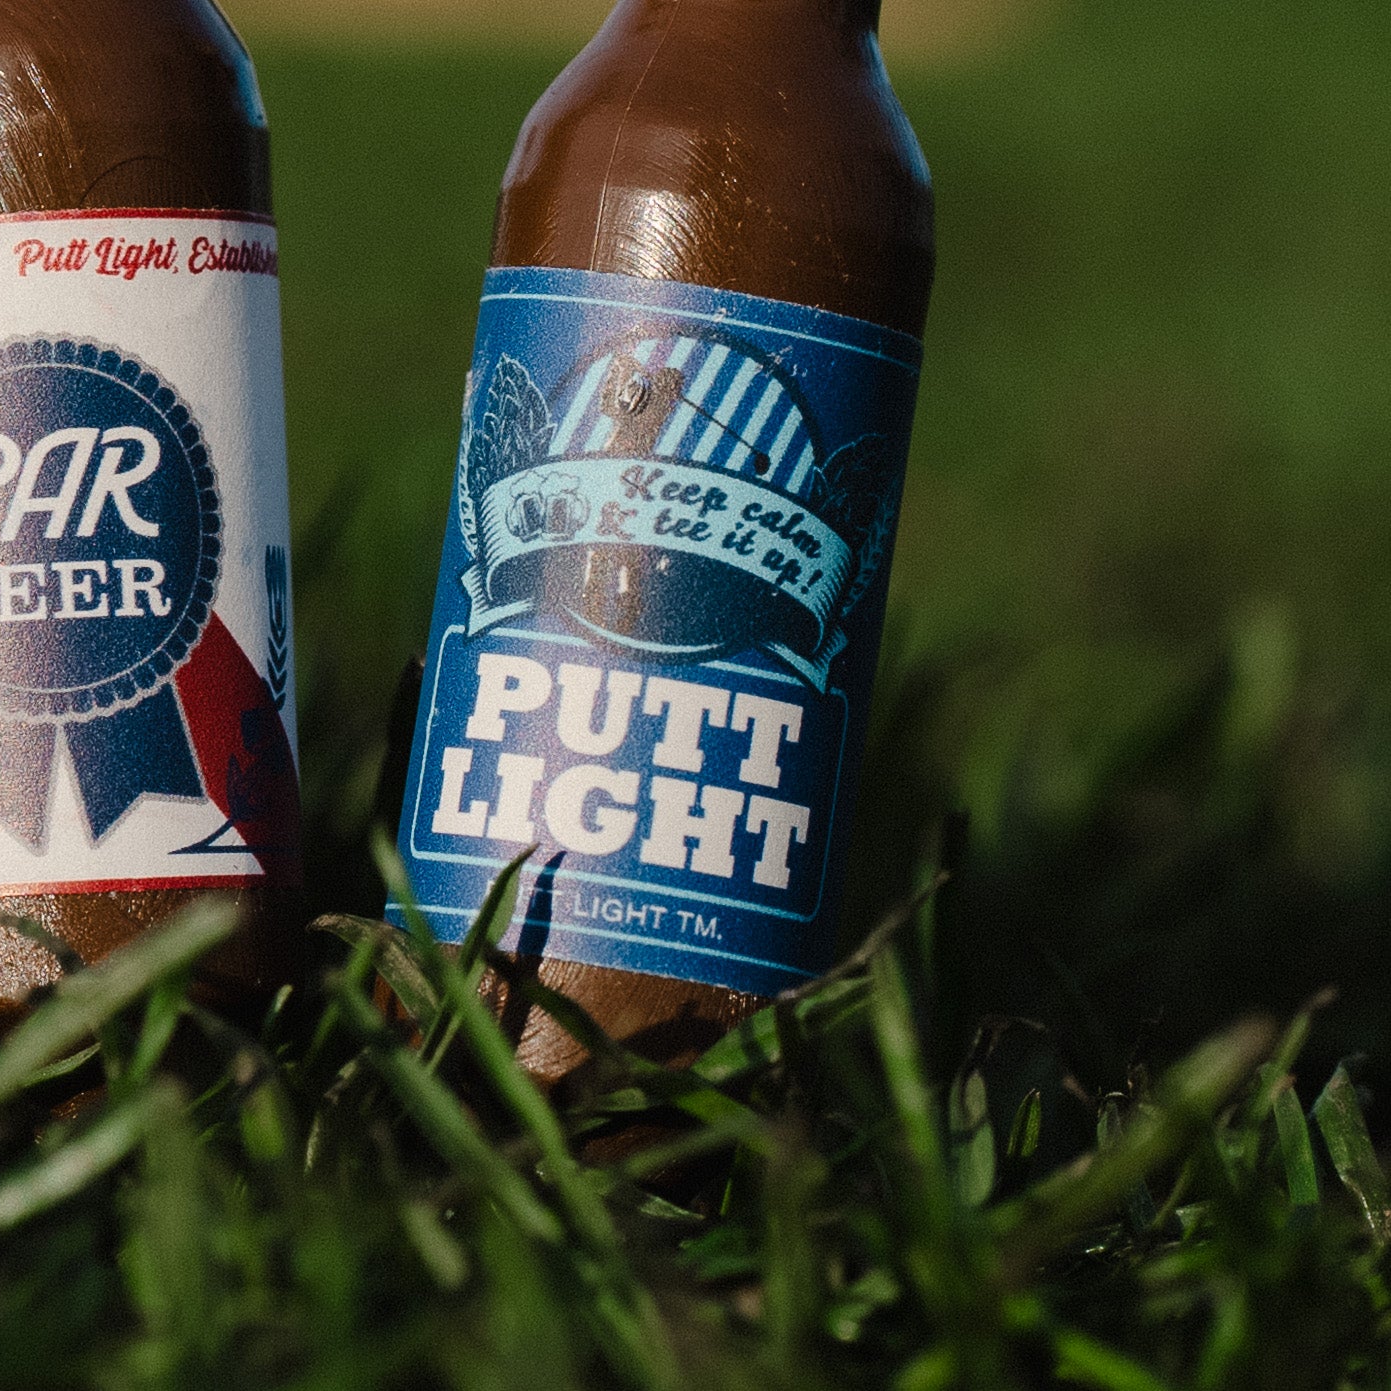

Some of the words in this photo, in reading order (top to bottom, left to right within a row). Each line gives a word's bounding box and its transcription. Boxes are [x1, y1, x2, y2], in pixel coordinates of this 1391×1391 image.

[13, 238, 90, 277] Putt
[620, 464, 728, 517] Keep
[742, 502, 821, 559] calm
[654, 508, 712, 542] tee
[722, 522, 757, 555] it
[762, 548, 824, 595] up!
[465, 652, 804, 789] PUTT
[431, 746, 810, 890] LIGHT
[572, 891, 668, 930] LIGHT
[676, 910, 723, 941] TM.
